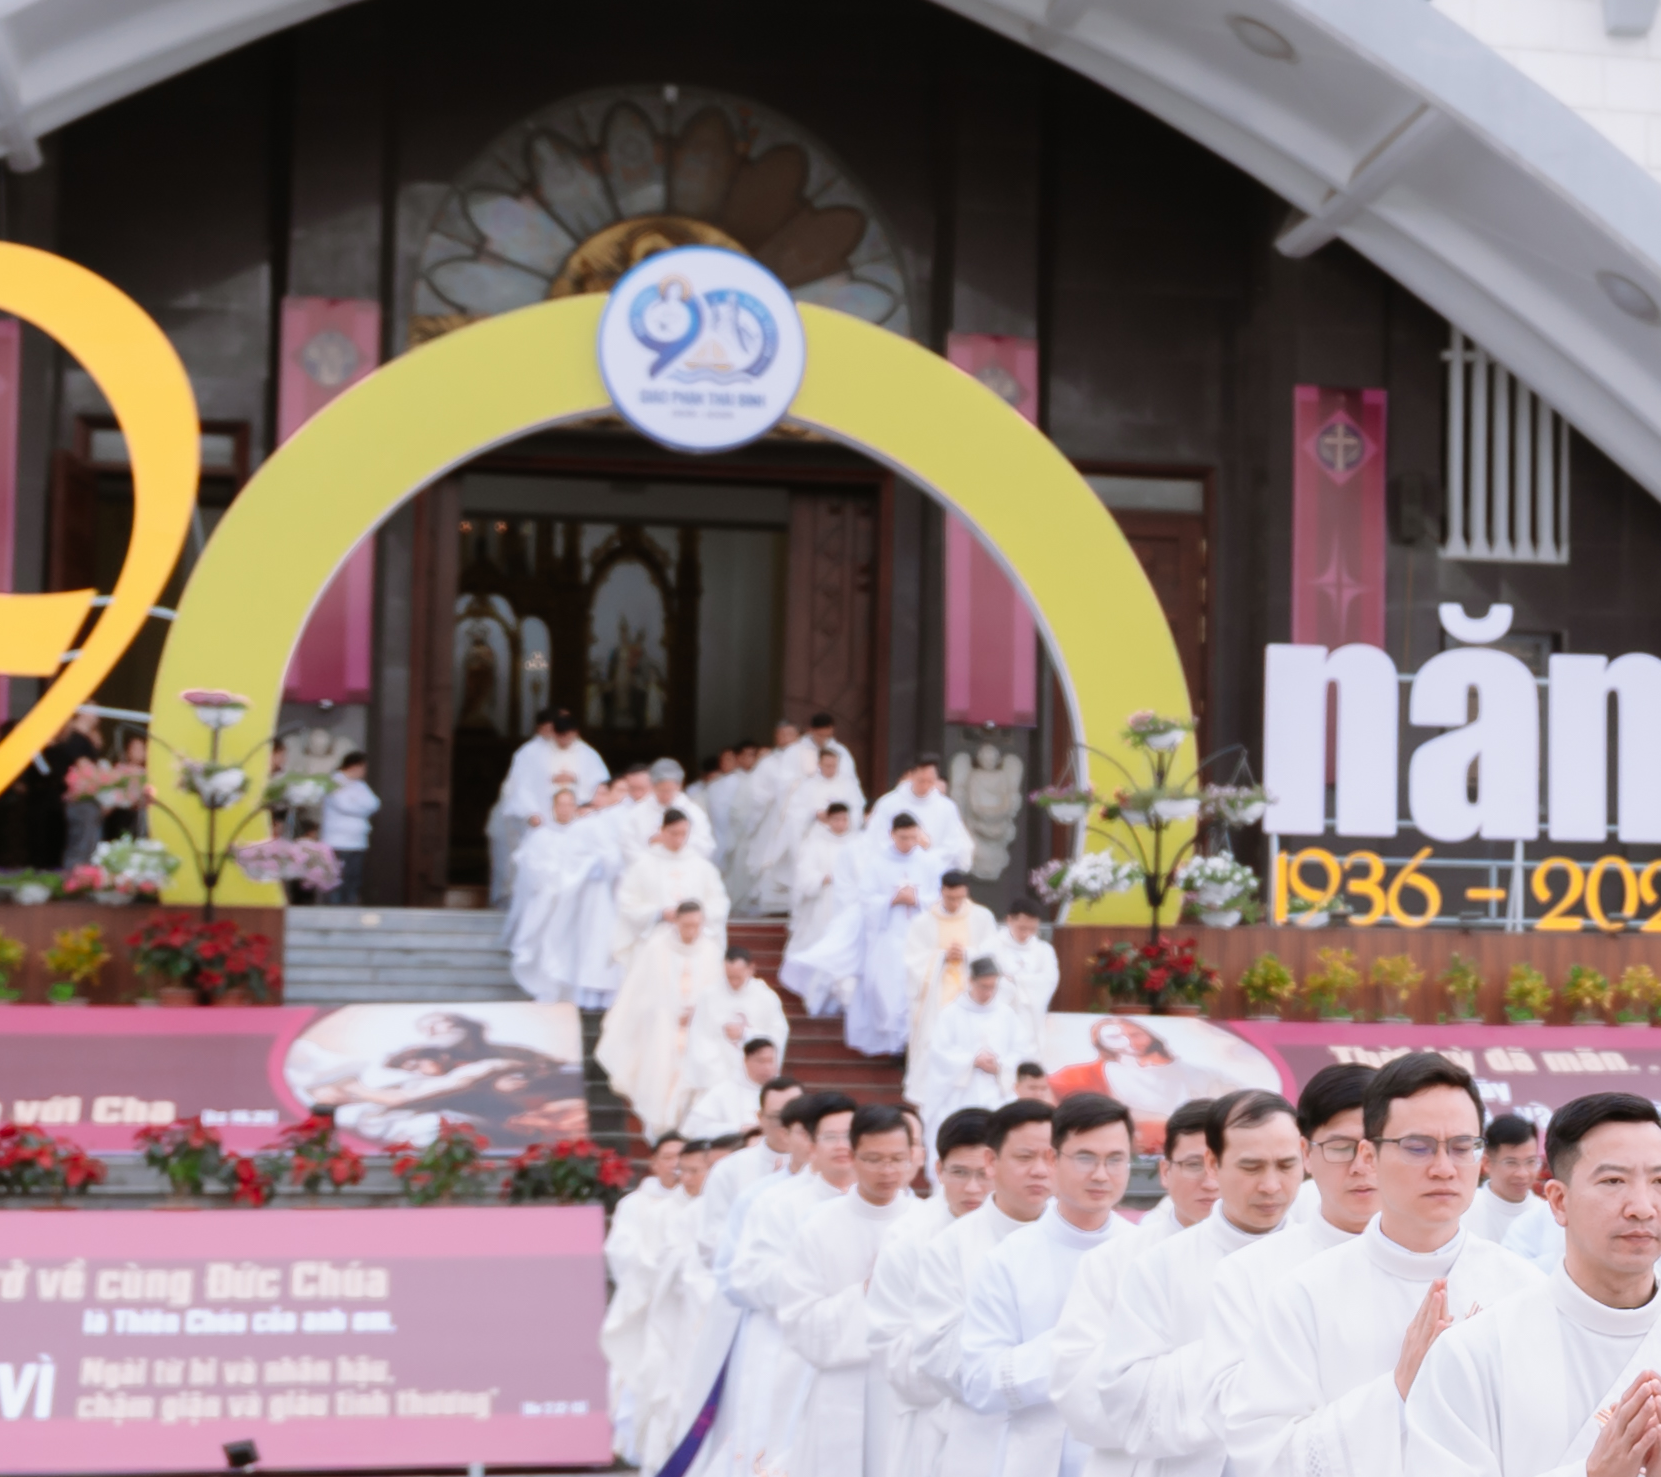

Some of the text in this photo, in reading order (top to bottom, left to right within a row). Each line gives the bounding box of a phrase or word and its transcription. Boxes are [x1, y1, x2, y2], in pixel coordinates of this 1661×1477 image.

[1274, 846, 1442, 928] 1936
[91, 1095, 177, 1125] Cha
[291, 1260, 389, 1301] Chúa
